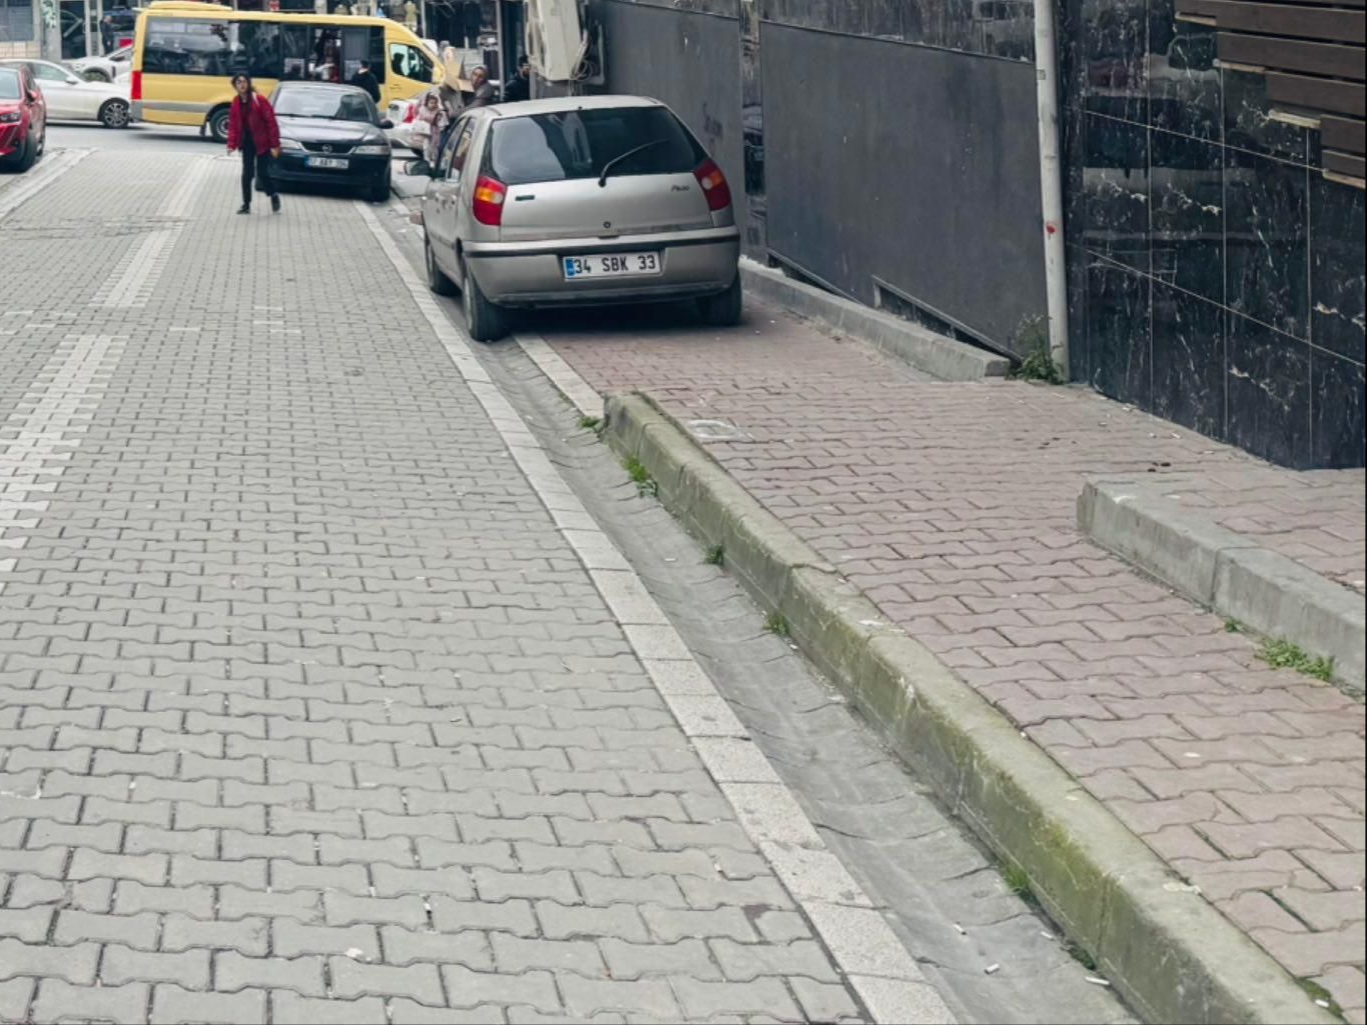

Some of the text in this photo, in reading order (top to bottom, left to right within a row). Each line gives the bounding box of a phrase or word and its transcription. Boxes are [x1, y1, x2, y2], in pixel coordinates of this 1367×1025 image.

[574, 254, 656, 275] 34 SBK 33
